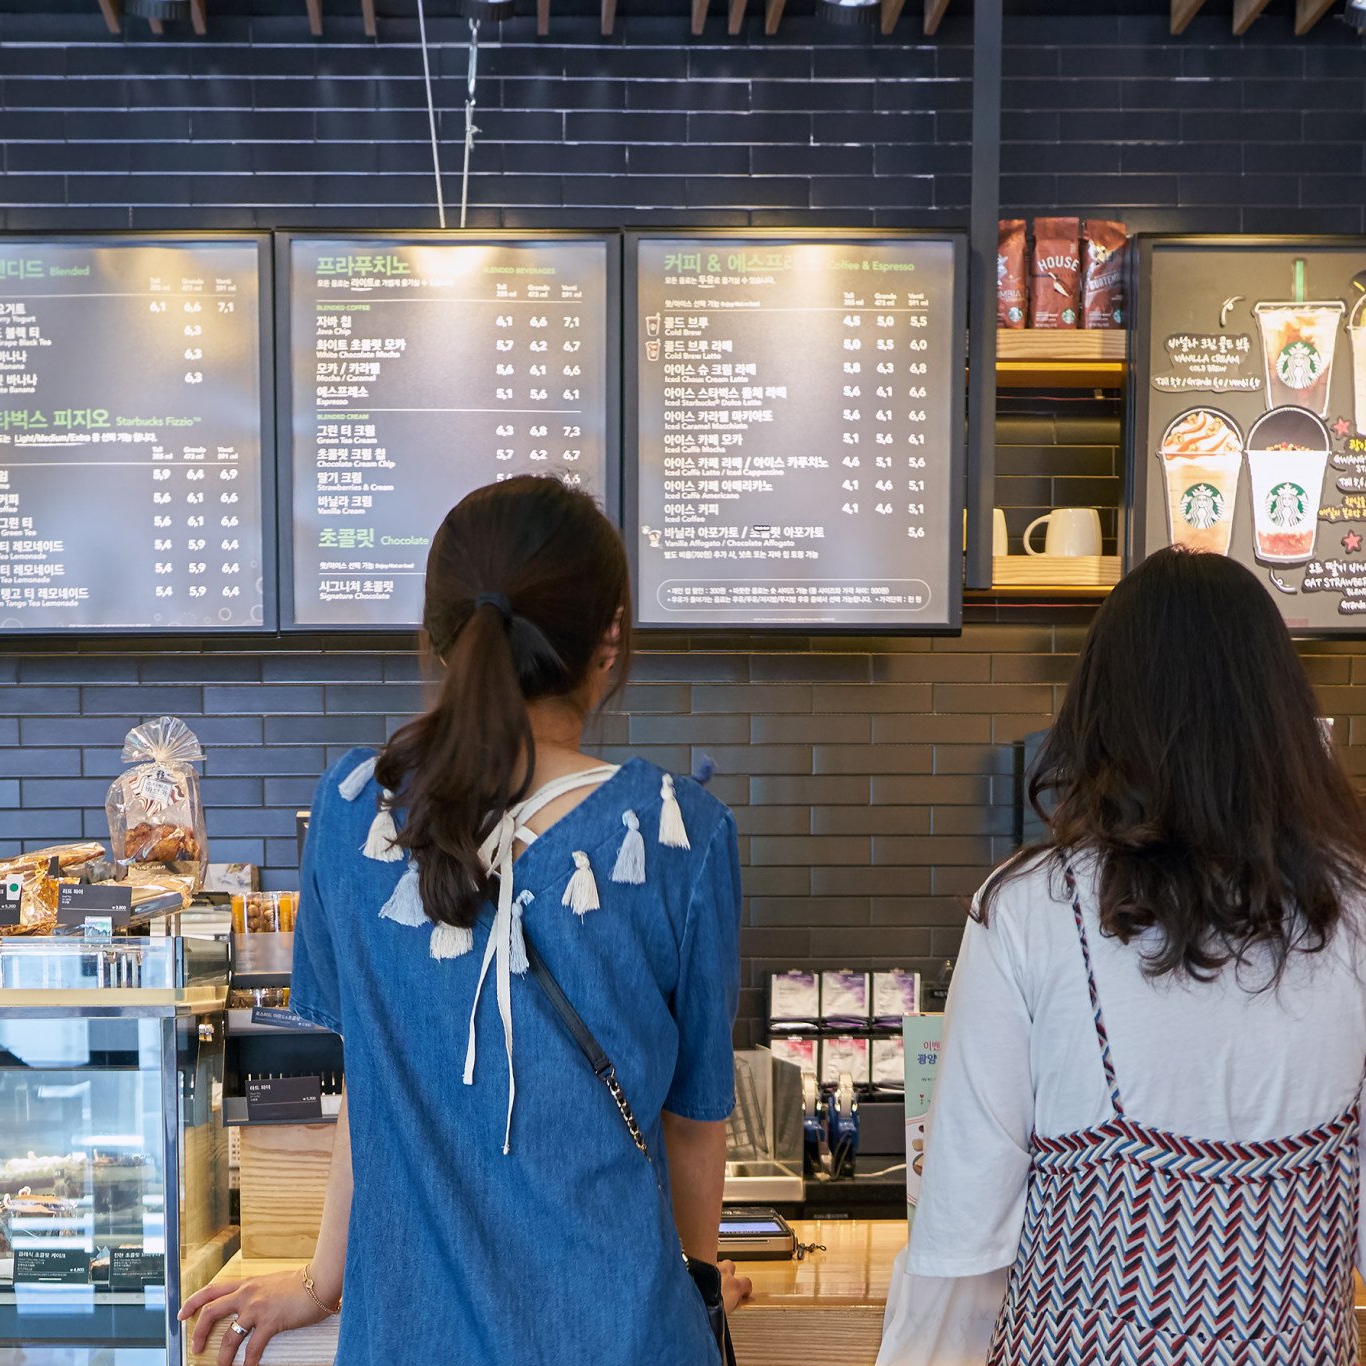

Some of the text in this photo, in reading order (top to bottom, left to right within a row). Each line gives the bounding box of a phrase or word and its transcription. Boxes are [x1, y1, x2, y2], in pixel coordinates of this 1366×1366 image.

[317, 256, 410, 275] 프라푸치노
[664, 254, 701, 274] 커피
[707, 254, 722, 272] &
[861, 261, 870, 271] &
[872, 261, 915, 273] Espresso
[1037, 255, 1079, 271] HOUSE
[50, 266, 89, 276] Blended
[1174, 354, 1240, 364] VANILLA CREAM
[53, 410, 110, 429] 피지오
[116, 417, 163, 427] Starbucks
[664, 503, 719, 516] 아이스 커피
[683, 515, 705, 523] Coffee
[319, 528, 429, 547] 초콜릿 Chocolate
[665, 526, 738, 539] 바닐라 아포가토
[665, 539, 687, 547] Vanilla
[689, 539, 719, 548] Affogato
[728, 539, 762, 547] Chocolate
[764, 539, 795, 548] Affogato
[364, 581, 393, 593] 초콜릿
[1304, 579, 1322, 587] OAT
[355, 592, 390, 600] Chocolate
[917, 1054, 937, 1064] 광양
